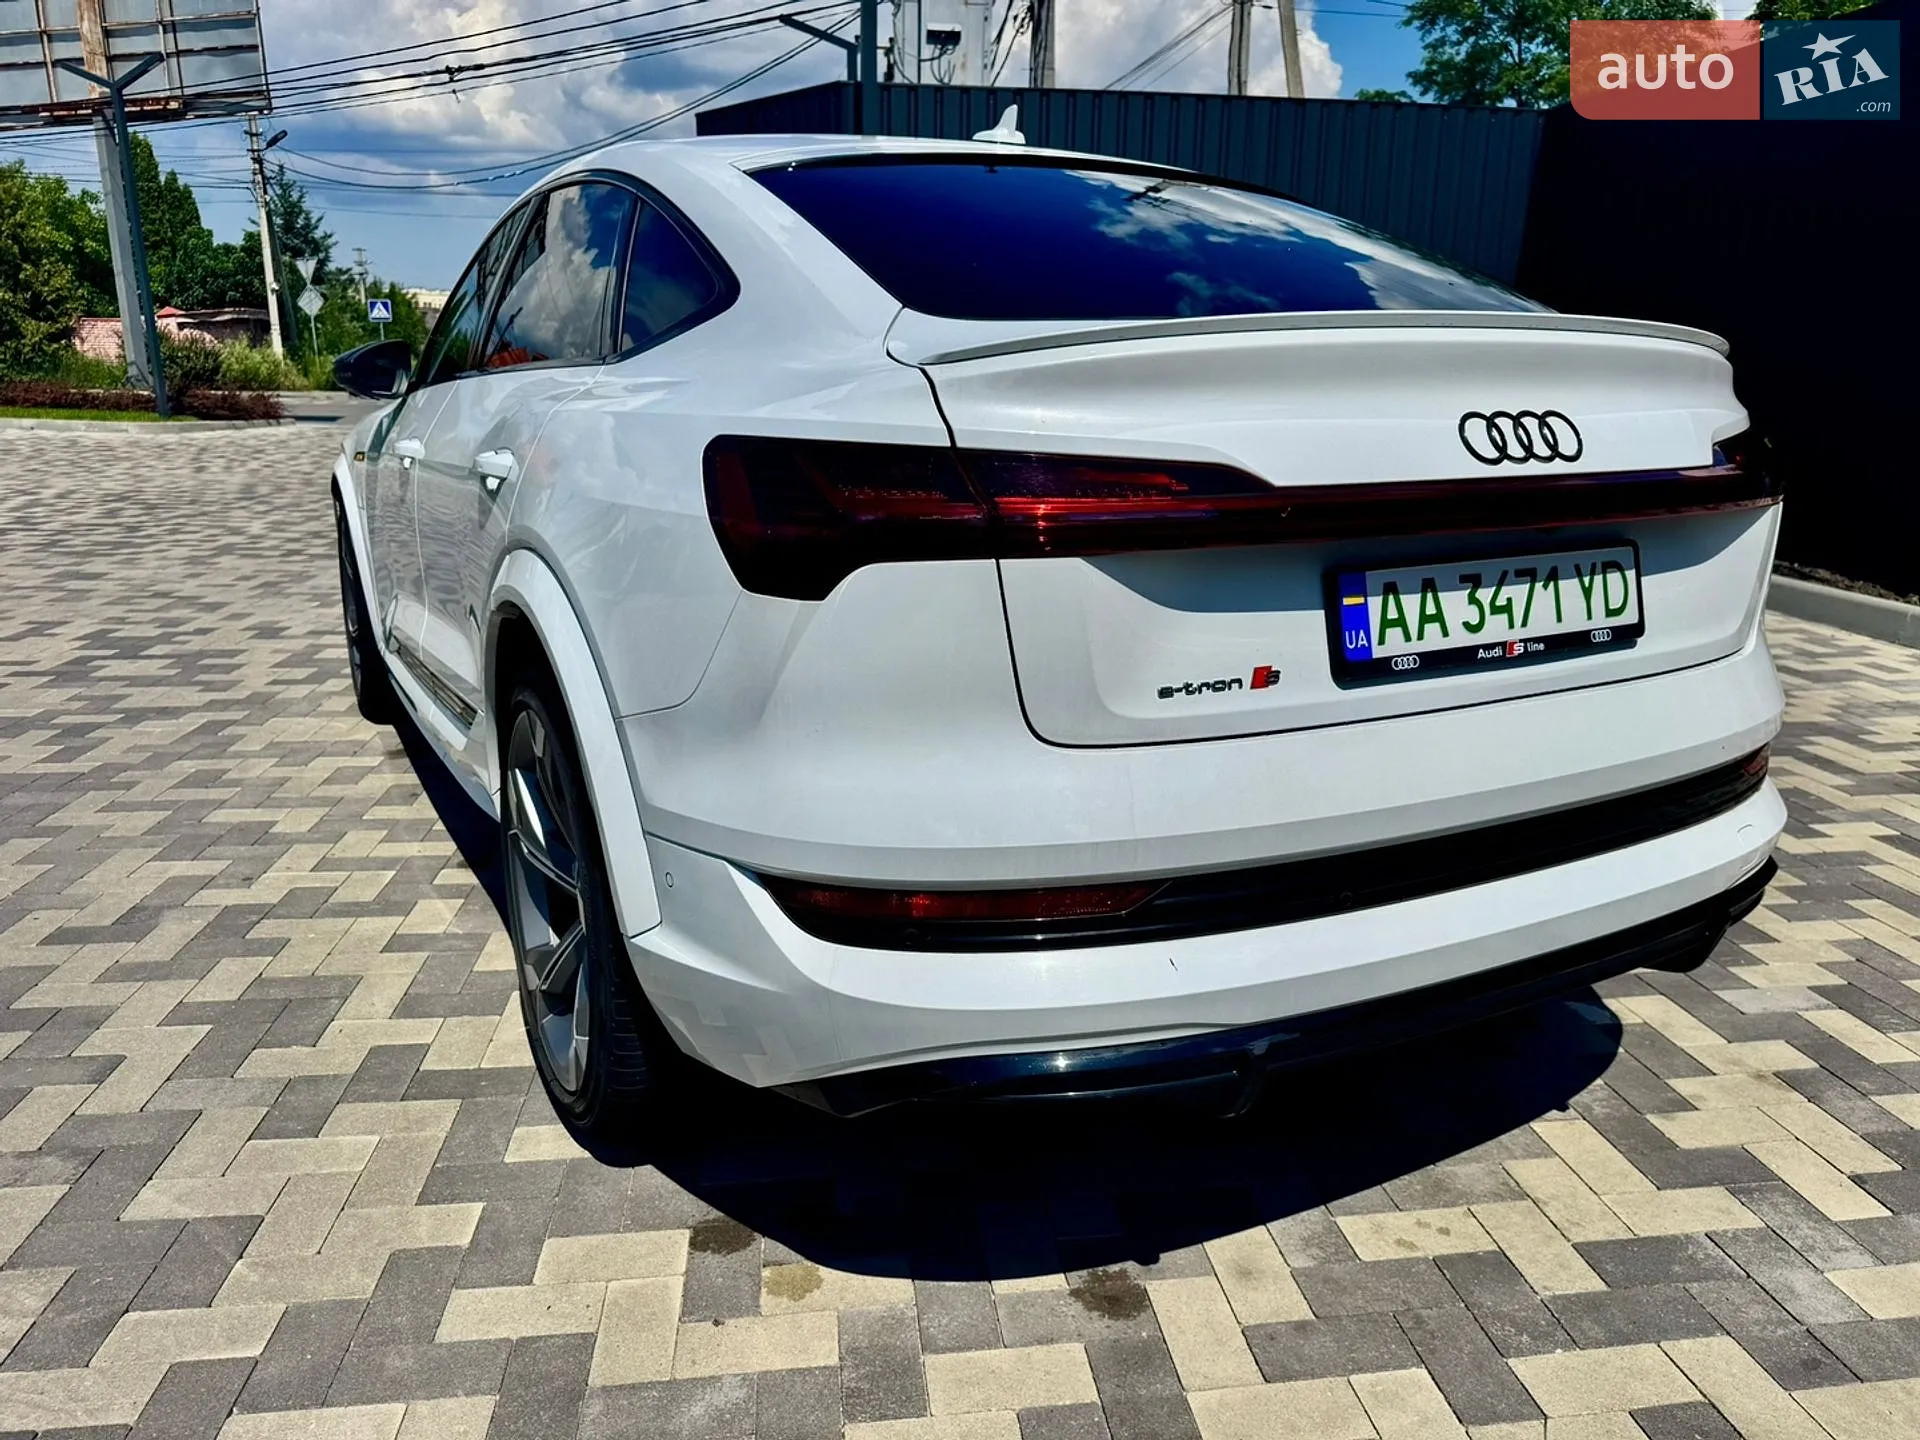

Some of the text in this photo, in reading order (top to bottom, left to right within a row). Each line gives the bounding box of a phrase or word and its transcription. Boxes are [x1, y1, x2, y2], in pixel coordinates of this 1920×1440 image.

[1377, 560, 1629, 646] AA 3471 YD
[1345, 630, 1369, 649] UA
[1477, 645, 1503, 659] Audi
[1527, 641, 1545, 652] line
[1157, 678, 1243, 699] e-tron
